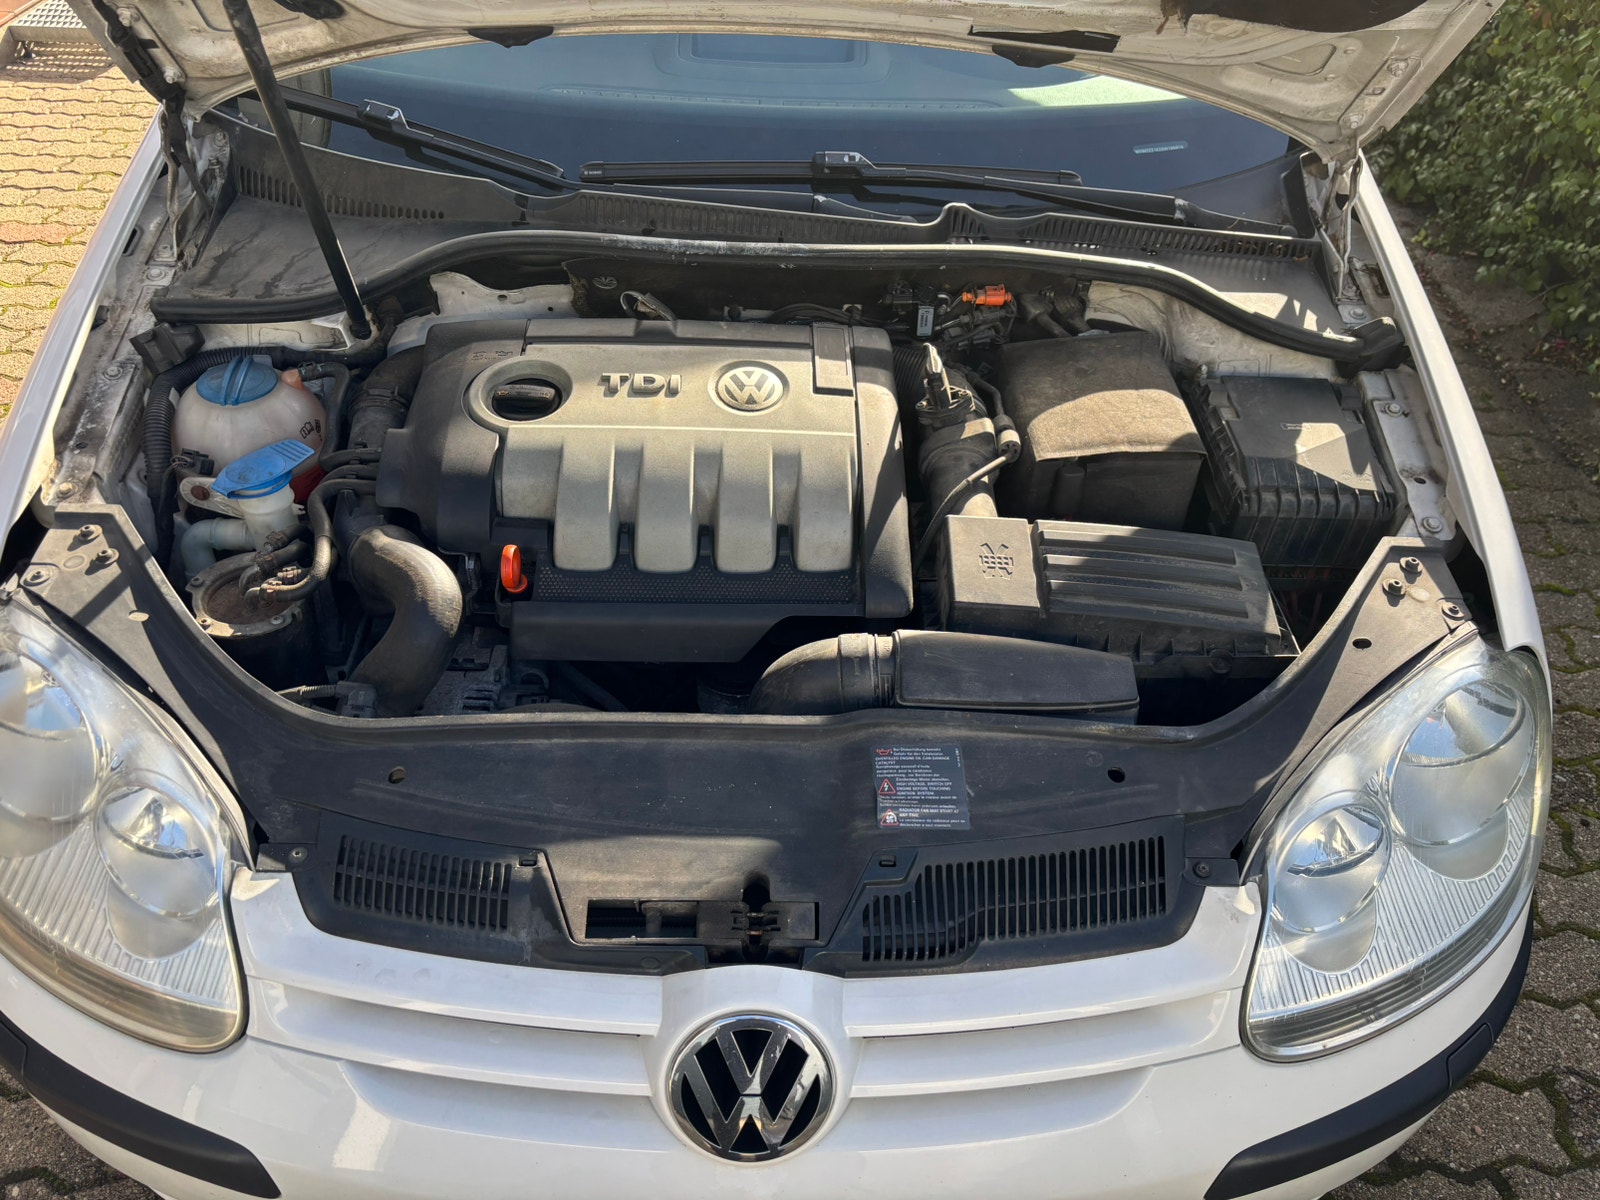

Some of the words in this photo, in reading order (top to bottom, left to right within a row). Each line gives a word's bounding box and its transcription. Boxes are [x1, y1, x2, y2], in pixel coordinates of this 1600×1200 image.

[600, 372, 682, 398] TDI
[717, 365, 784, 412] VW
[669, 1014, 834, 1162] VW
